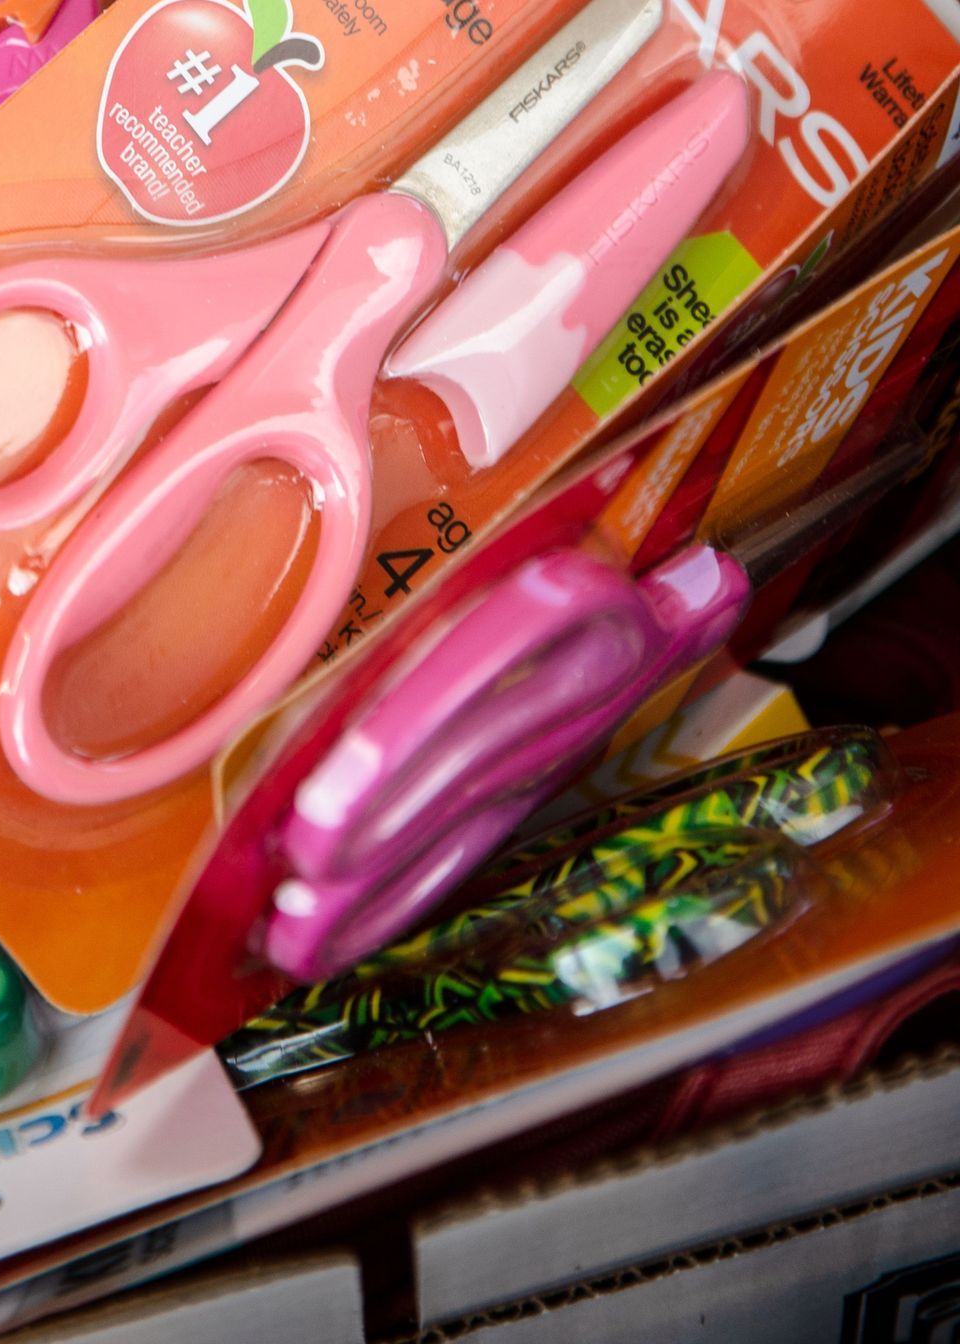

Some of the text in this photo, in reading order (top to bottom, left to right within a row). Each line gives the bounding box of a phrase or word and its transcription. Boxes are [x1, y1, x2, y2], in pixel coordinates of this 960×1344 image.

[166, 48, 260, 146] #1
[108, 102, 205, 215] recommended
[120, 142, 171, 201] brand!
[147, 105, 207, 177] teacher
[652, 296, 680, 332] is
[810, 247, 950, 443] KIDS
[776, 282, 896, 469] SCISSORS
[376, 548, 435, 599] 4
